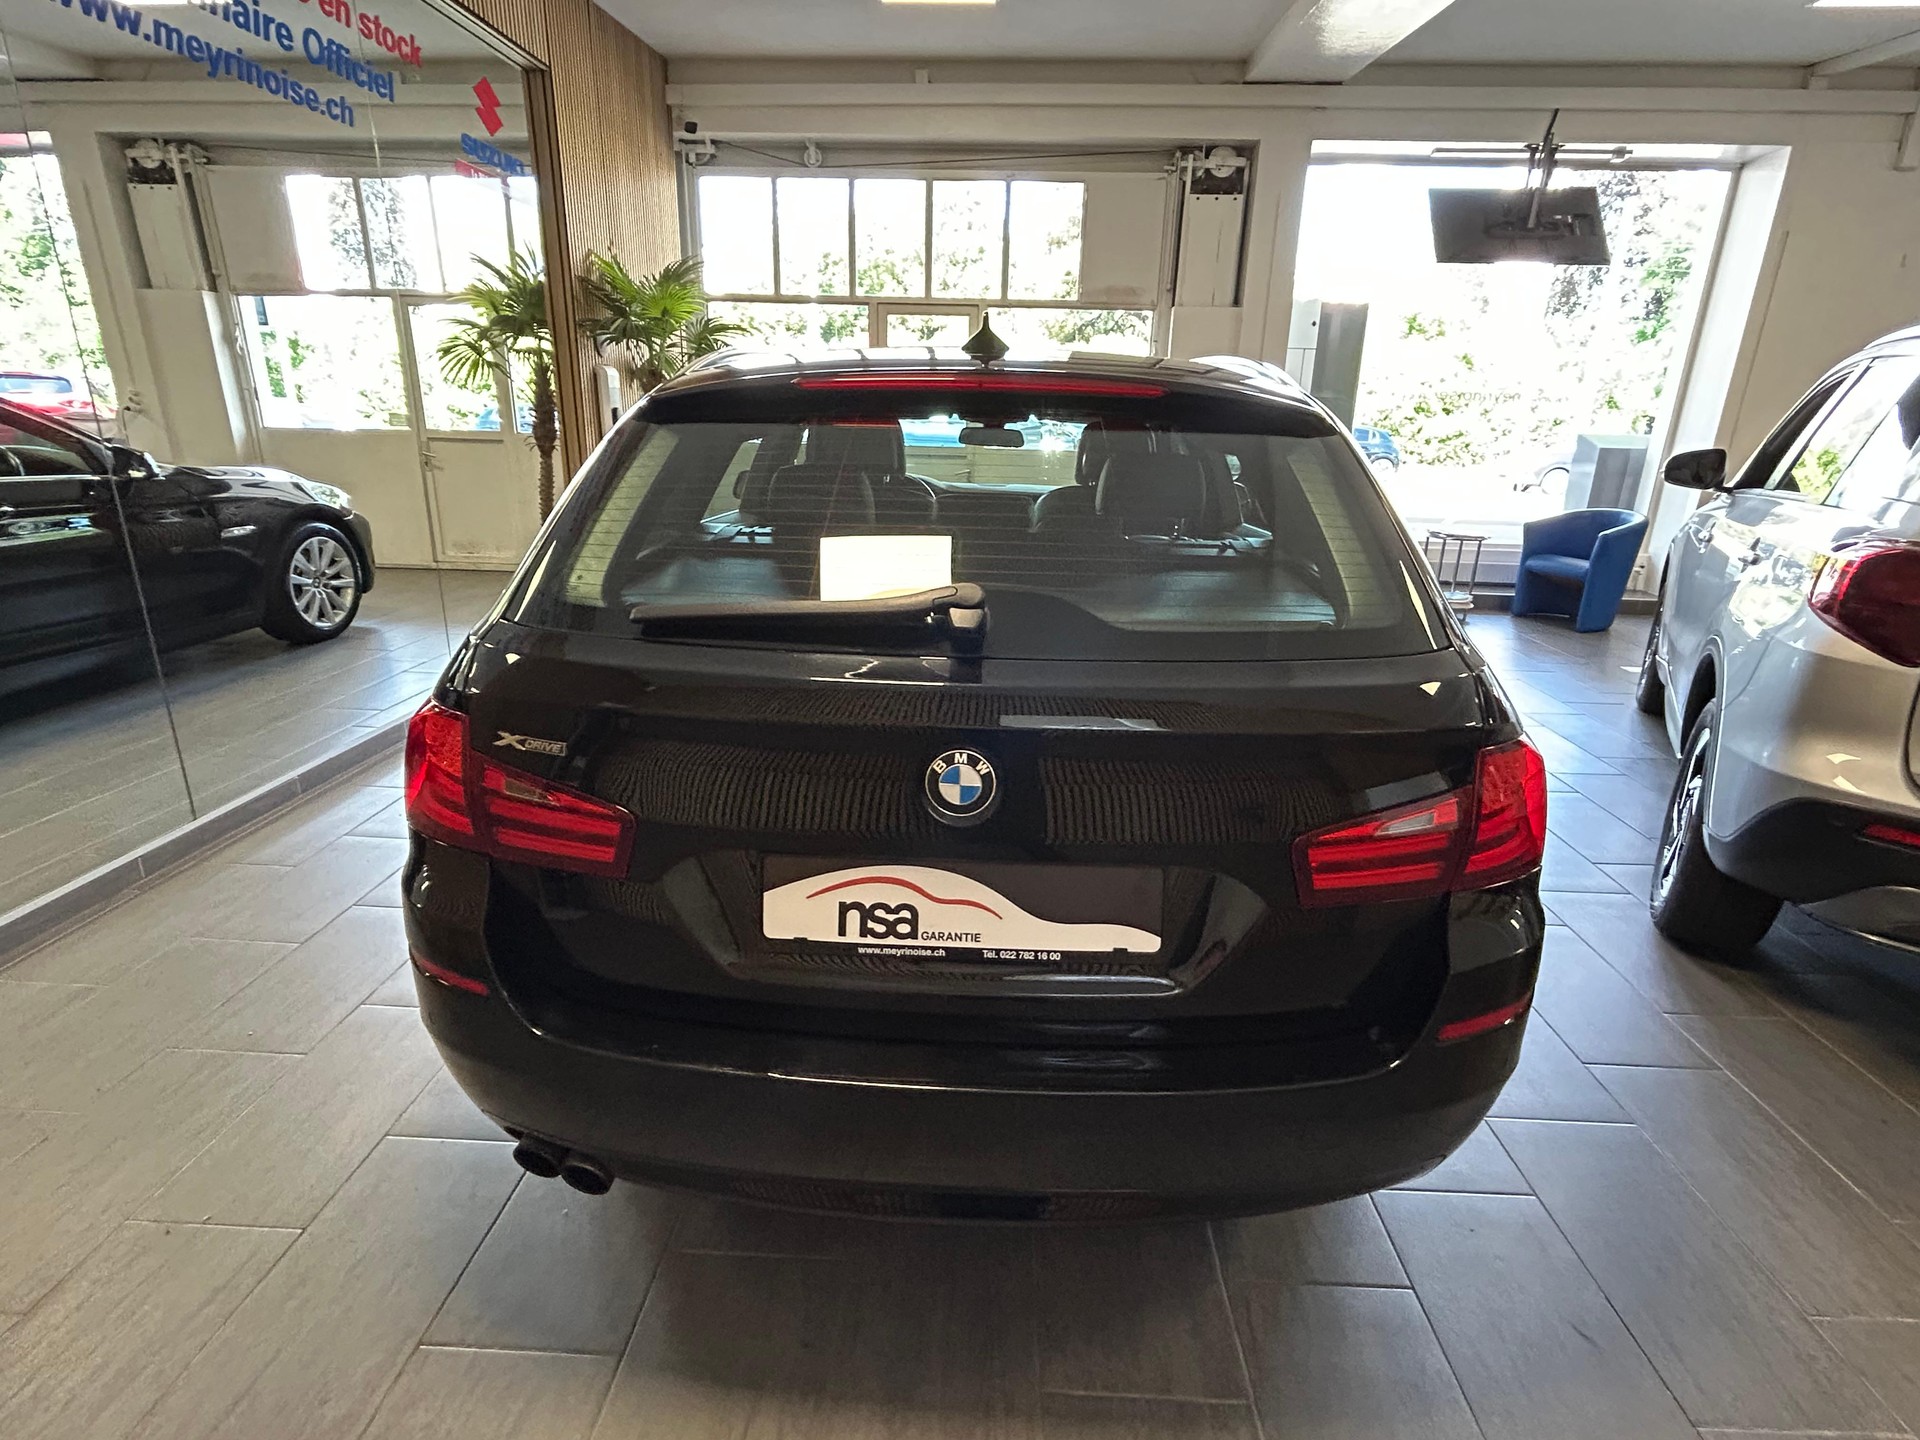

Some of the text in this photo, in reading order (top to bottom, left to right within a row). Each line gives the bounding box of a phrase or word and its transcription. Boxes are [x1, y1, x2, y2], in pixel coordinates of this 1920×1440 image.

[199, 0, 394, 102] naire Officiel
[319, 0, 423, 67] en stock
[50, 0, 354, 127] ww.meyrinoise.ch
[933, 752, 990, 776] BMW
[838, 901, 981, 943] nsa GARANTIE
[858, 946, 946, 957] www.meyrinoise.ch
[1000, 950, 1017, 960] 022
[1018, 951, 1034, 960] 782
[1037, 951, 1048, 961] 16
[1050, 952, 1061, 961] 00
